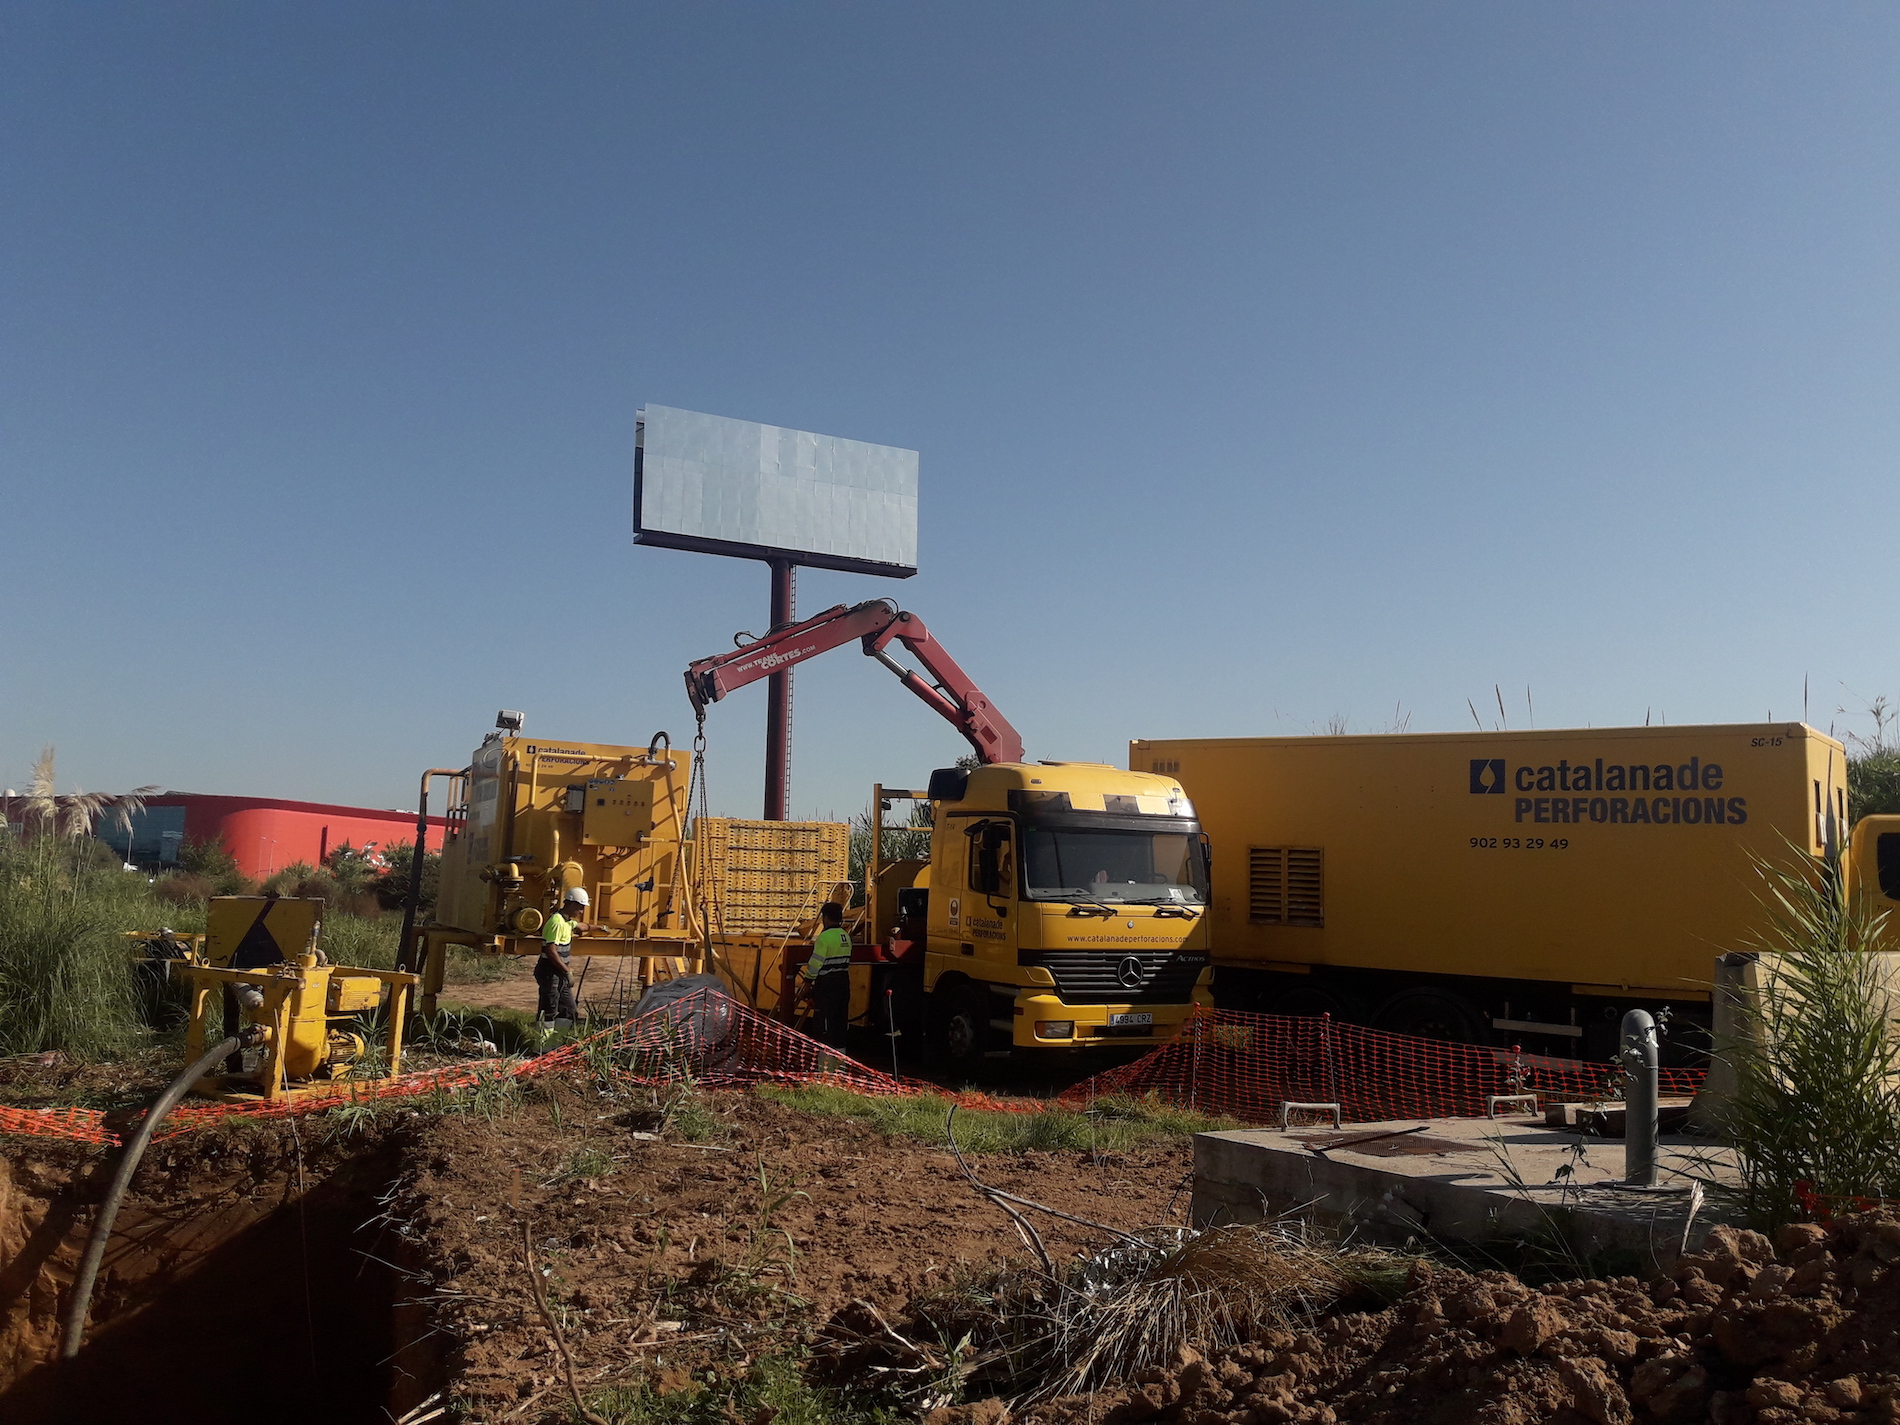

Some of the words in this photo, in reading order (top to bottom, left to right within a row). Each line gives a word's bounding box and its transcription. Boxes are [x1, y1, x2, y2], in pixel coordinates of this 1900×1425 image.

[1751, 737, 1783, 747] SC-15
[1515, 757, 1723, 791] catalanade
[1515, 797, 1748, 825] PERFORACIONS
[1469, 837, 1498, 849] 902
[1502, 838, 1521, 849] 93
[1526, 838, 1544, 849] 29
[1549, 838, 1569, 849] 49
